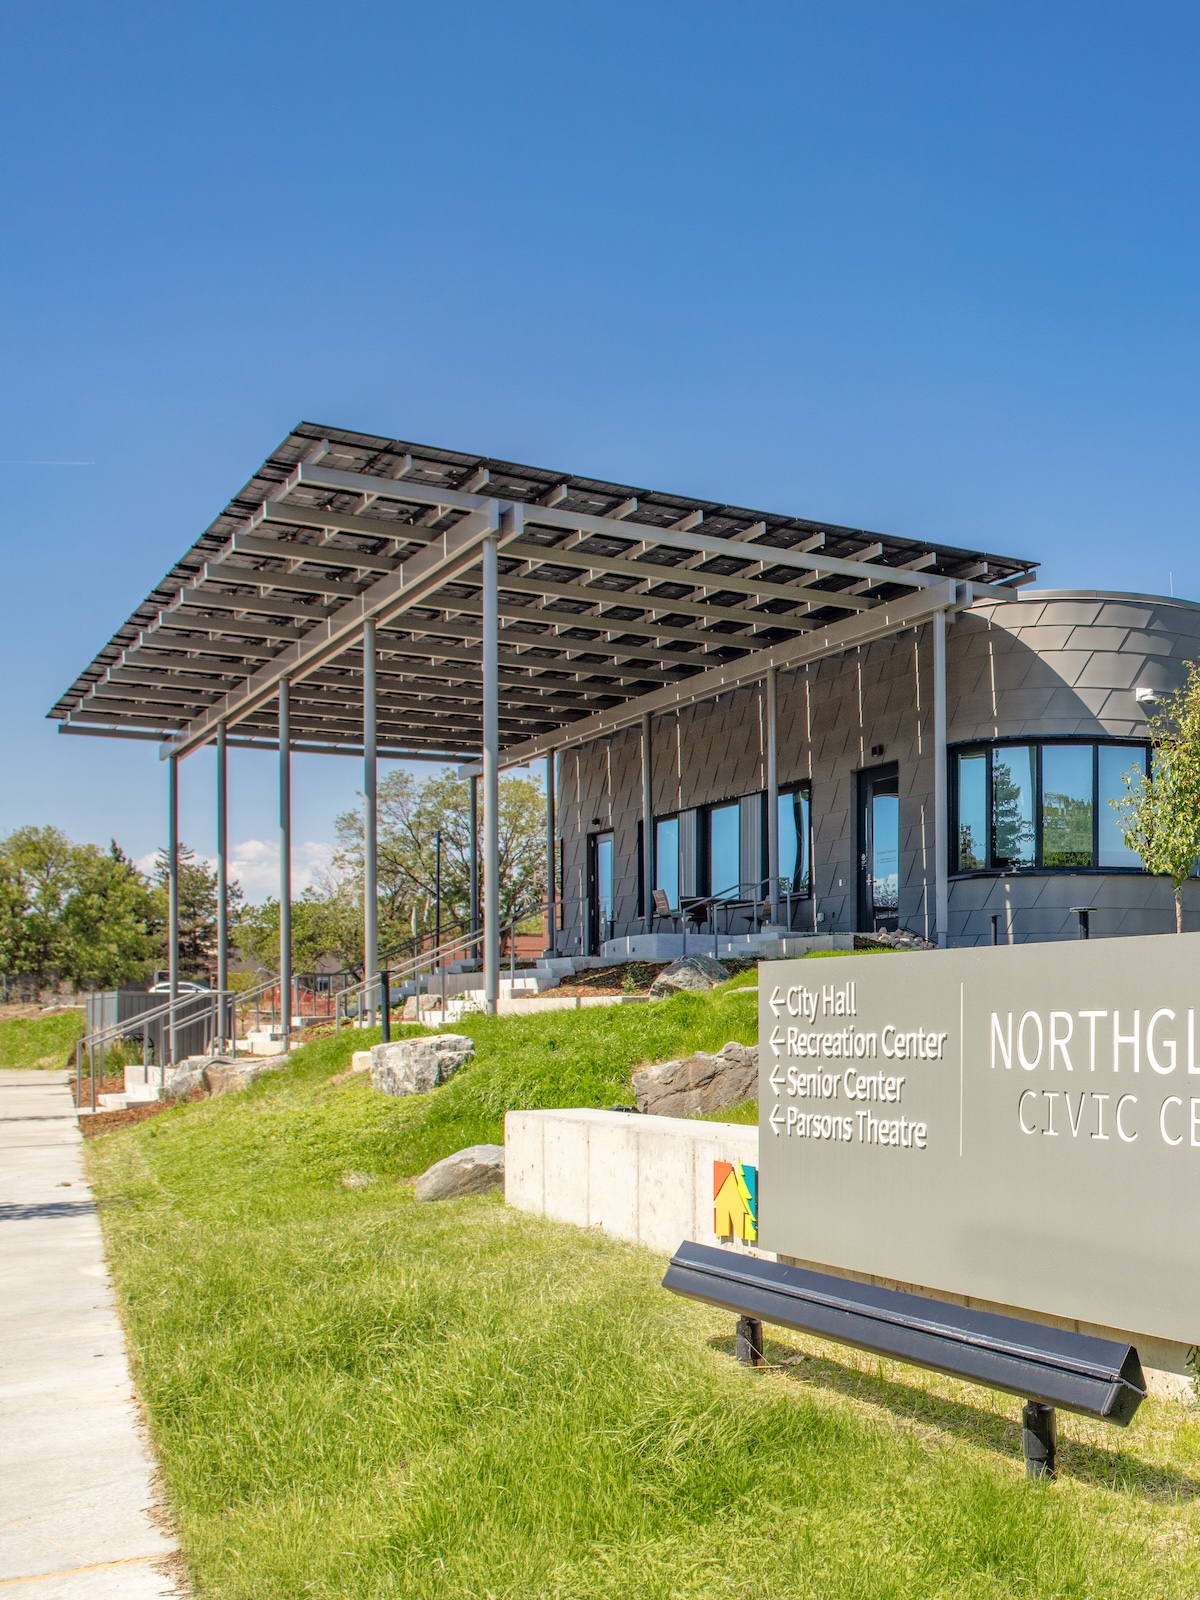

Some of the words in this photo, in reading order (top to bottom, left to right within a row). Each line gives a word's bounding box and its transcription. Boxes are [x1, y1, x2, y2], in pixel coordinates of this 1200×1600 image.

[786, 985, 819, 1024] City
[822, 982, 857, 1016] Hall
[787, 1025, 877, 1058] Recreation
[881, 1025, 947, 1059] Center
[786, 1066, 841, 1098] Senior
[844, 1068, 905, 1102] Center
[787, 1107, 853, 1141] Parsons
[856, 1109, 928, 1149] Theatre
[1018, 1089, 1138, 1142] CIVIC
